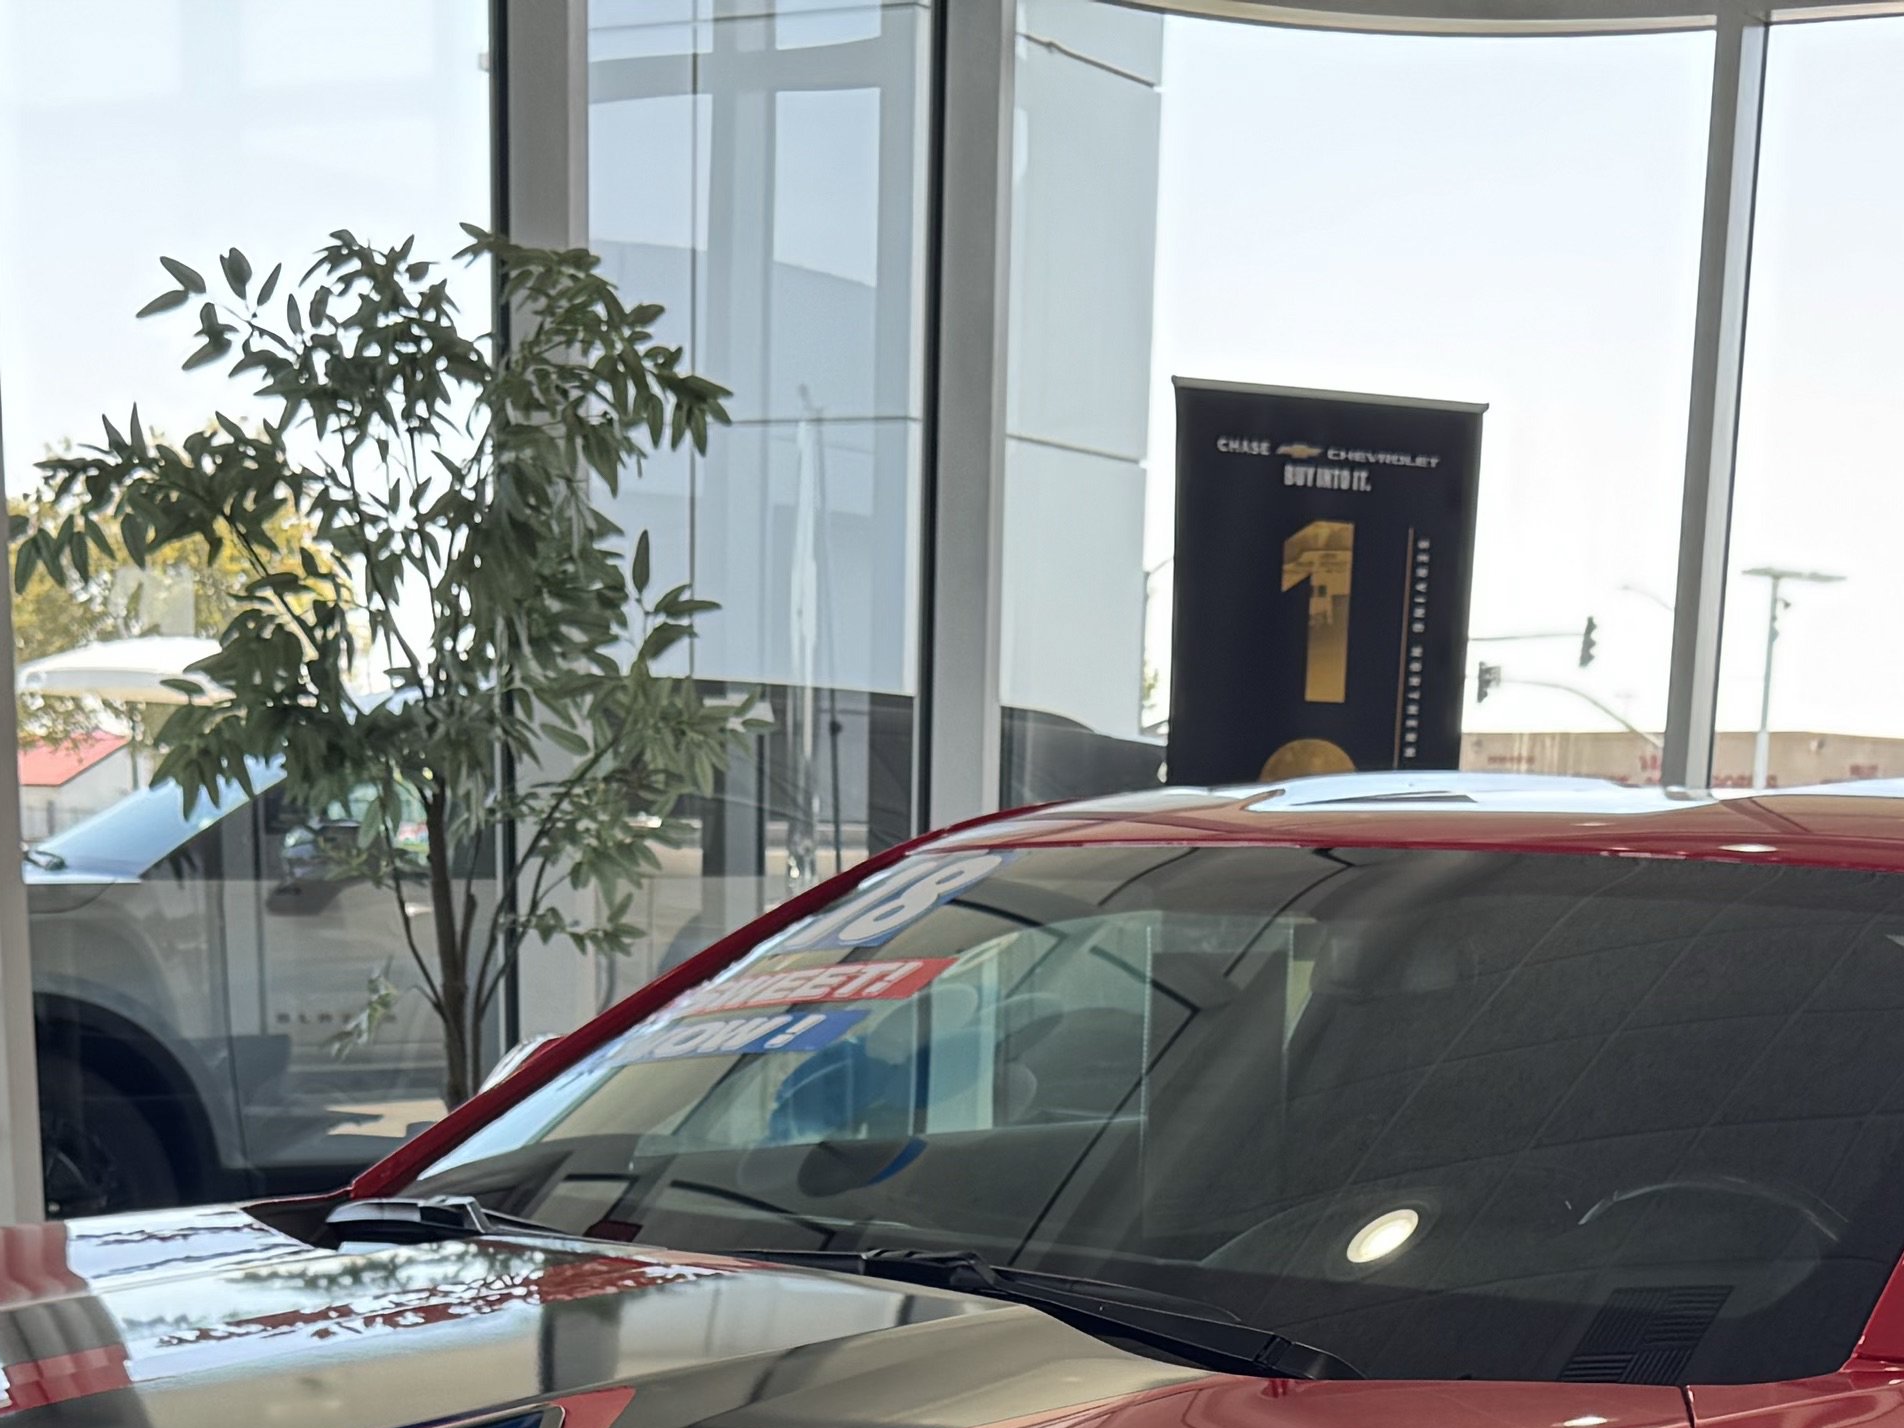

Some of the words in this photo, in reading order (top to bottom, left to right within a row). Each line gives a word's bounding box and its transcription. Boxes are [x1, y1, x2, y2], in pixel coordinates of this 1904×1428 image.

[1216, 435, 1271, 456] CHASE
[1327, 448, 1441, 469] CHEVROLET
[1283, 464, 1316, 487] BUY
[1316, 466, 1350, 490] INTO
